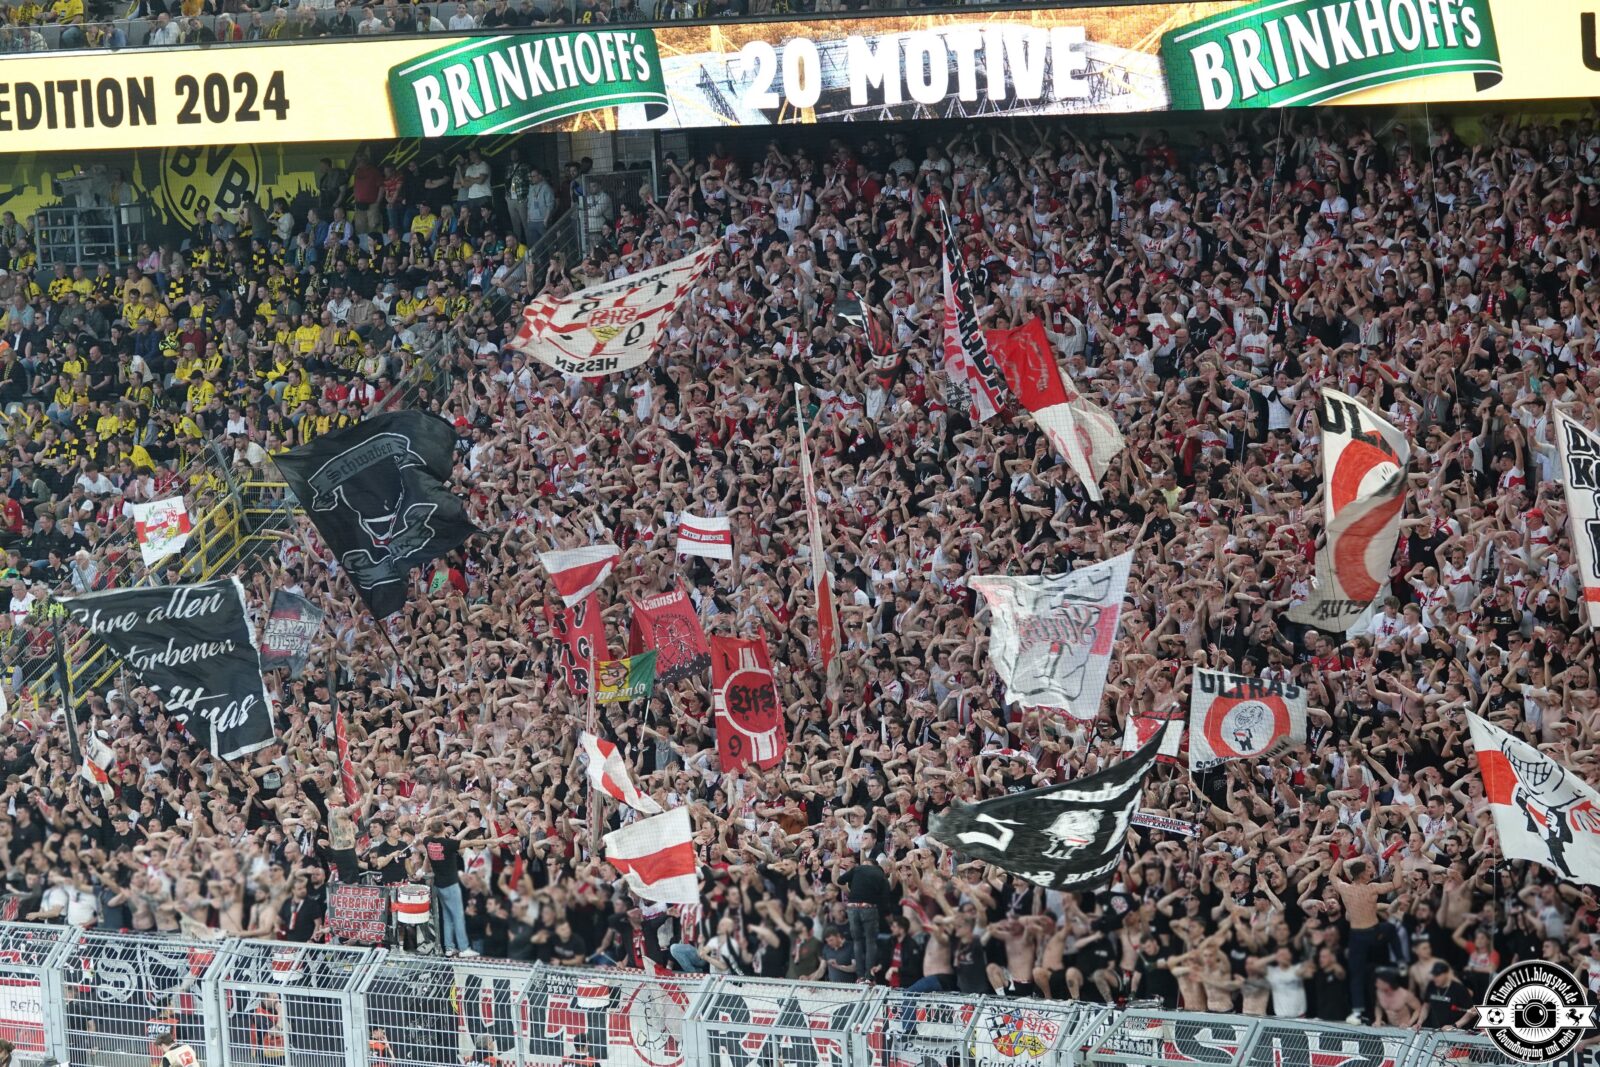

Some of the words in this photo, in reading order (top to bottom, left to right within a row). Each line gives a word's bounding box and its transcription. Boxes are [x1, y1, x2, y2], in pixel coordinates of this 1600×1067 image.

[740, 38, 822, 110] 20
[847, 26, 1090, 106] MOTIVE
[0, 76, 157, 132] EDITION
[174, 70, 290, 124] 2024
[326, 441, 394, 485] Schwaben
[145, 587, 226, 625] allen
[124, 637, 236, 668] torbenen
[1198, 671, 1300, 699] ULTRAS
[330, 894, 386, 911] VERBANNTE
[336, 886, 381, 896] JEDER
[334, 908, 382, 921] KEHRT
